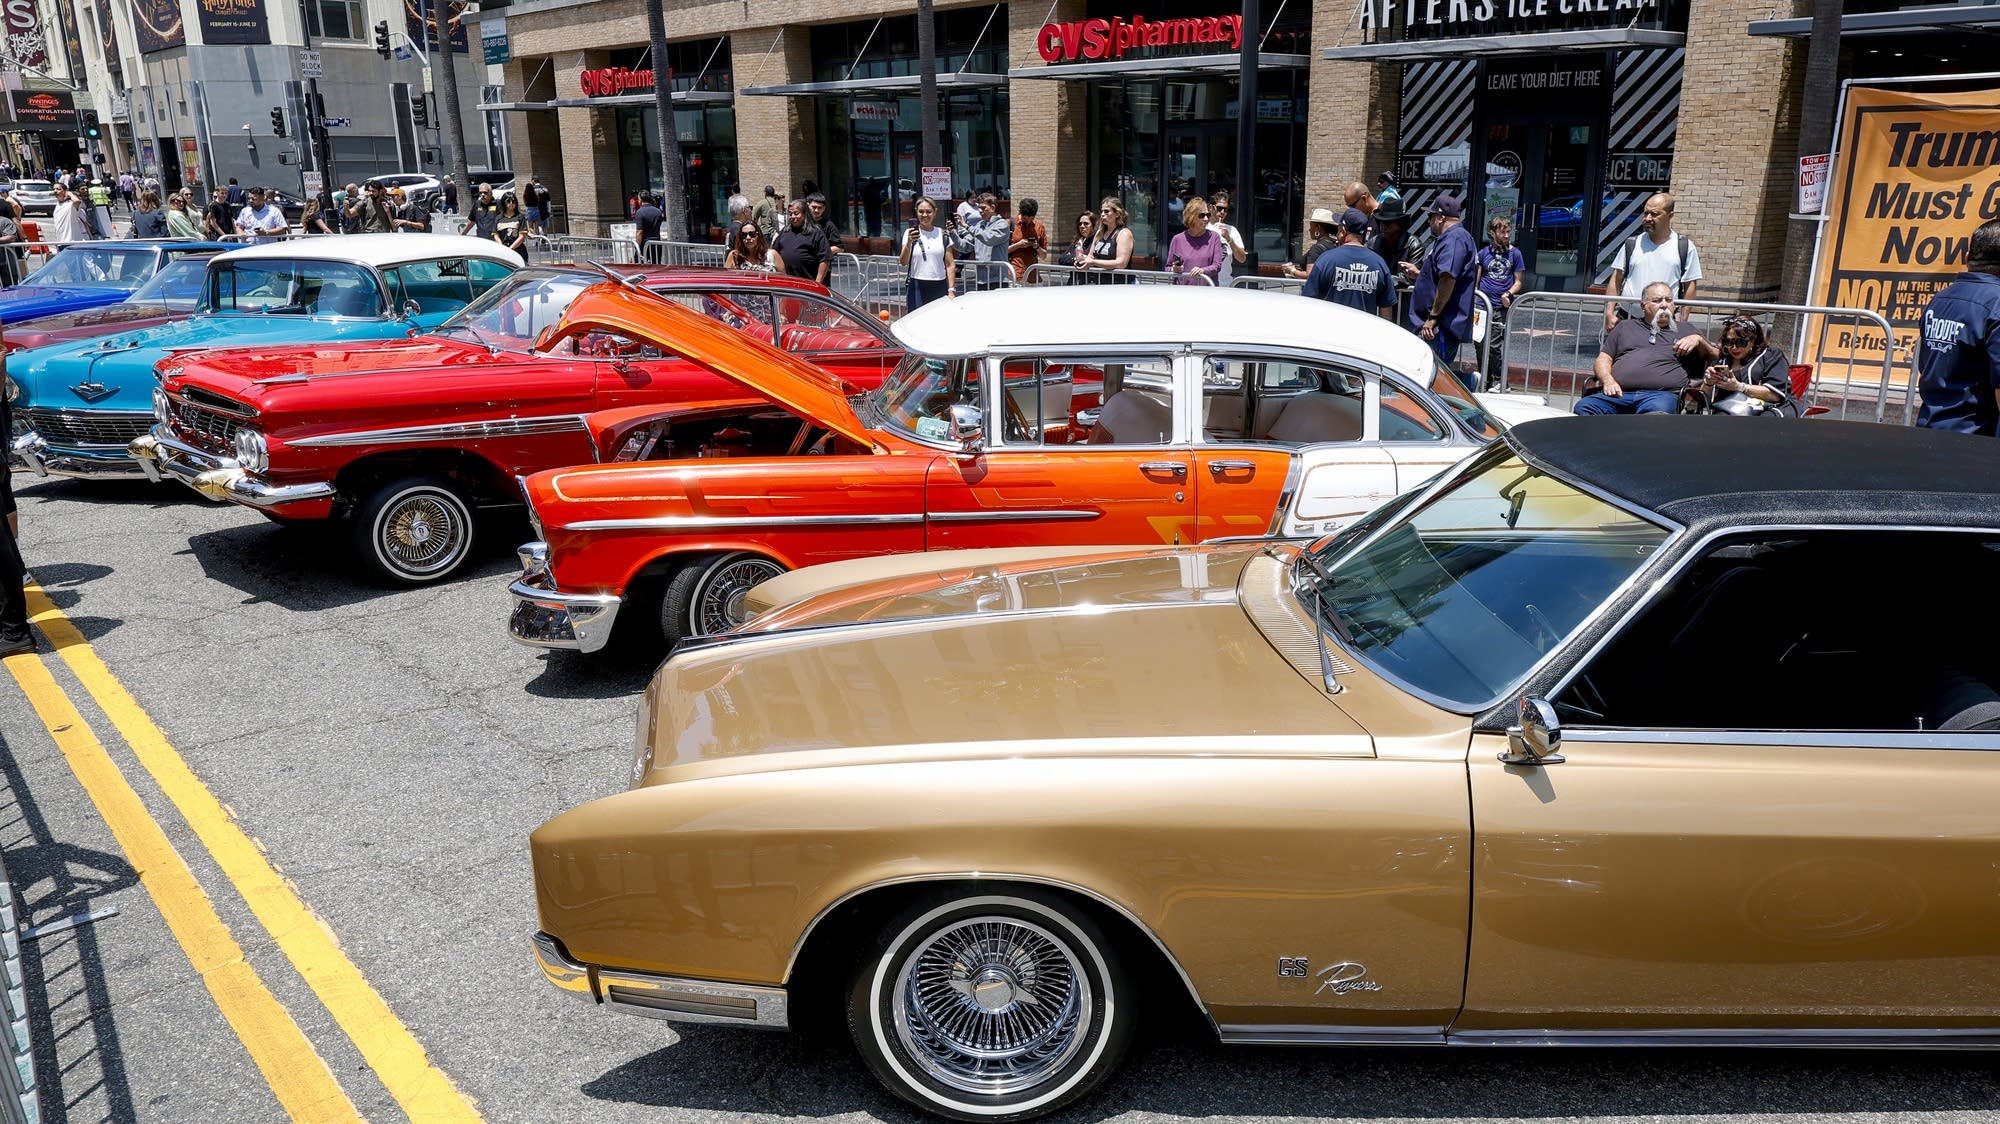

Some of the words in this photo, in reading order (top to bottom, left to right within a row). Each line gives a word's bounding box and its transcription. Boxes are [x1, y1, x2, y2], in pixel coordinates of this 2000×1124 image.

[1037, 15, 1243, 62] CVS/pharmacy
[301, 62, 320, 70] BLOCK
[580, 66, 673, 97] CVS/pharma
[1487, 73, 1518, 90] LEAVE
[1520, 72, 1547, 88] YOUR
[1549, 71, 1572, 88] DIET
[1574, 70, 1601, 87] HERE
[1401, 160, 1420, 179] ICE
[1422, 160, 1466, 180] CREAM
[1610, 159, 1633, 180] ICE
[1802, 171, 1815, 185] NO
[1864, 182, 1973, 220] Must
[1350, 262, 1369, 272] NEW
[1333, 266, 1379, 291] EDITION
[1896, 281, 1909, 291] IN
[1911, 281, 1931, 292] THE
[1836, 278, 1893, 321] NO!
[1896, 292, 1915, 304] WE
[1892, 307, 1902, 320] A
[1278, 955, 1309, 978] GS
[1314, 960, 1383, 996] Riviera
